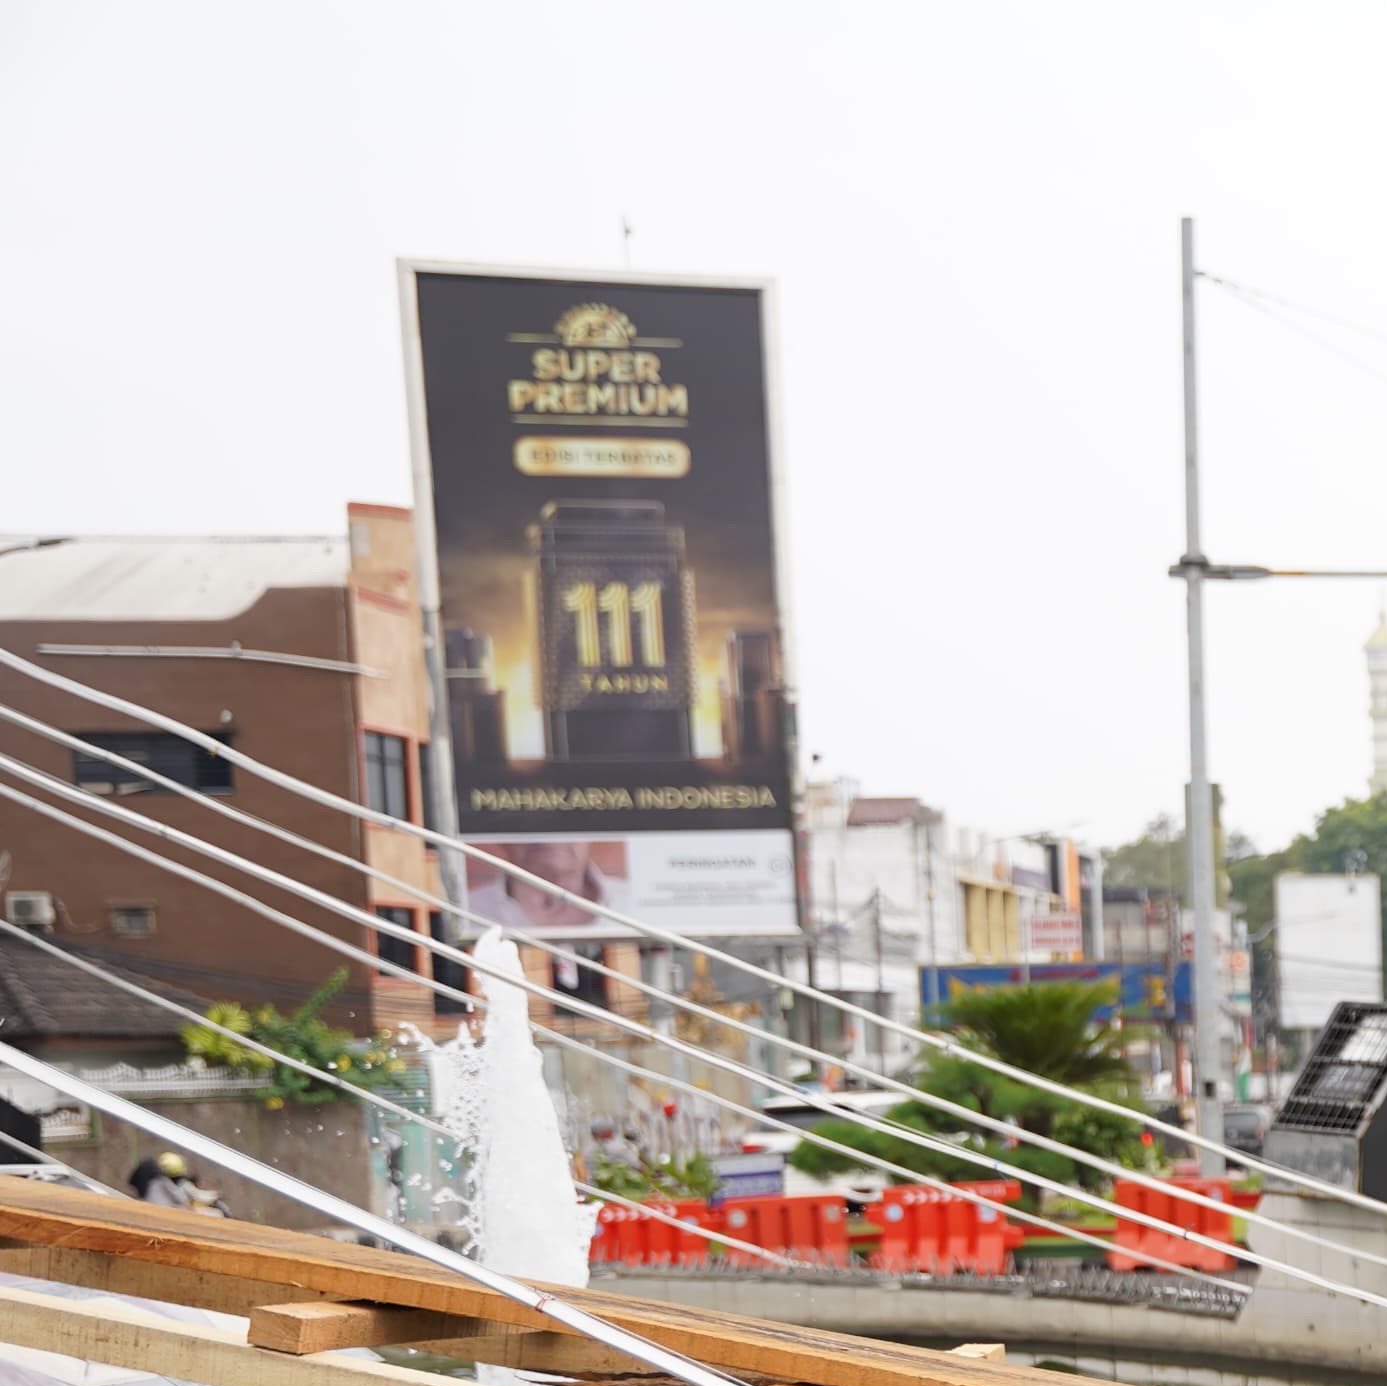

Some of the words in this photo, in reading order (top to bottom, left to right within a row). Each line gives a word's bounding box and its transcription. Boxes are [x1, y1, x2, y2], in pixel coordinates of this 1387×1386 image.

[532, 349, 661, 383] SUPER
[509, 379, 688, 415] PREMIUM
[563, 580, 667, 669] 111
[581, 674, 668, 694] TAHUN
[471, 787, 633, 812] MAHAKARYA
[638, 786, 777, 810] INDONESIA
